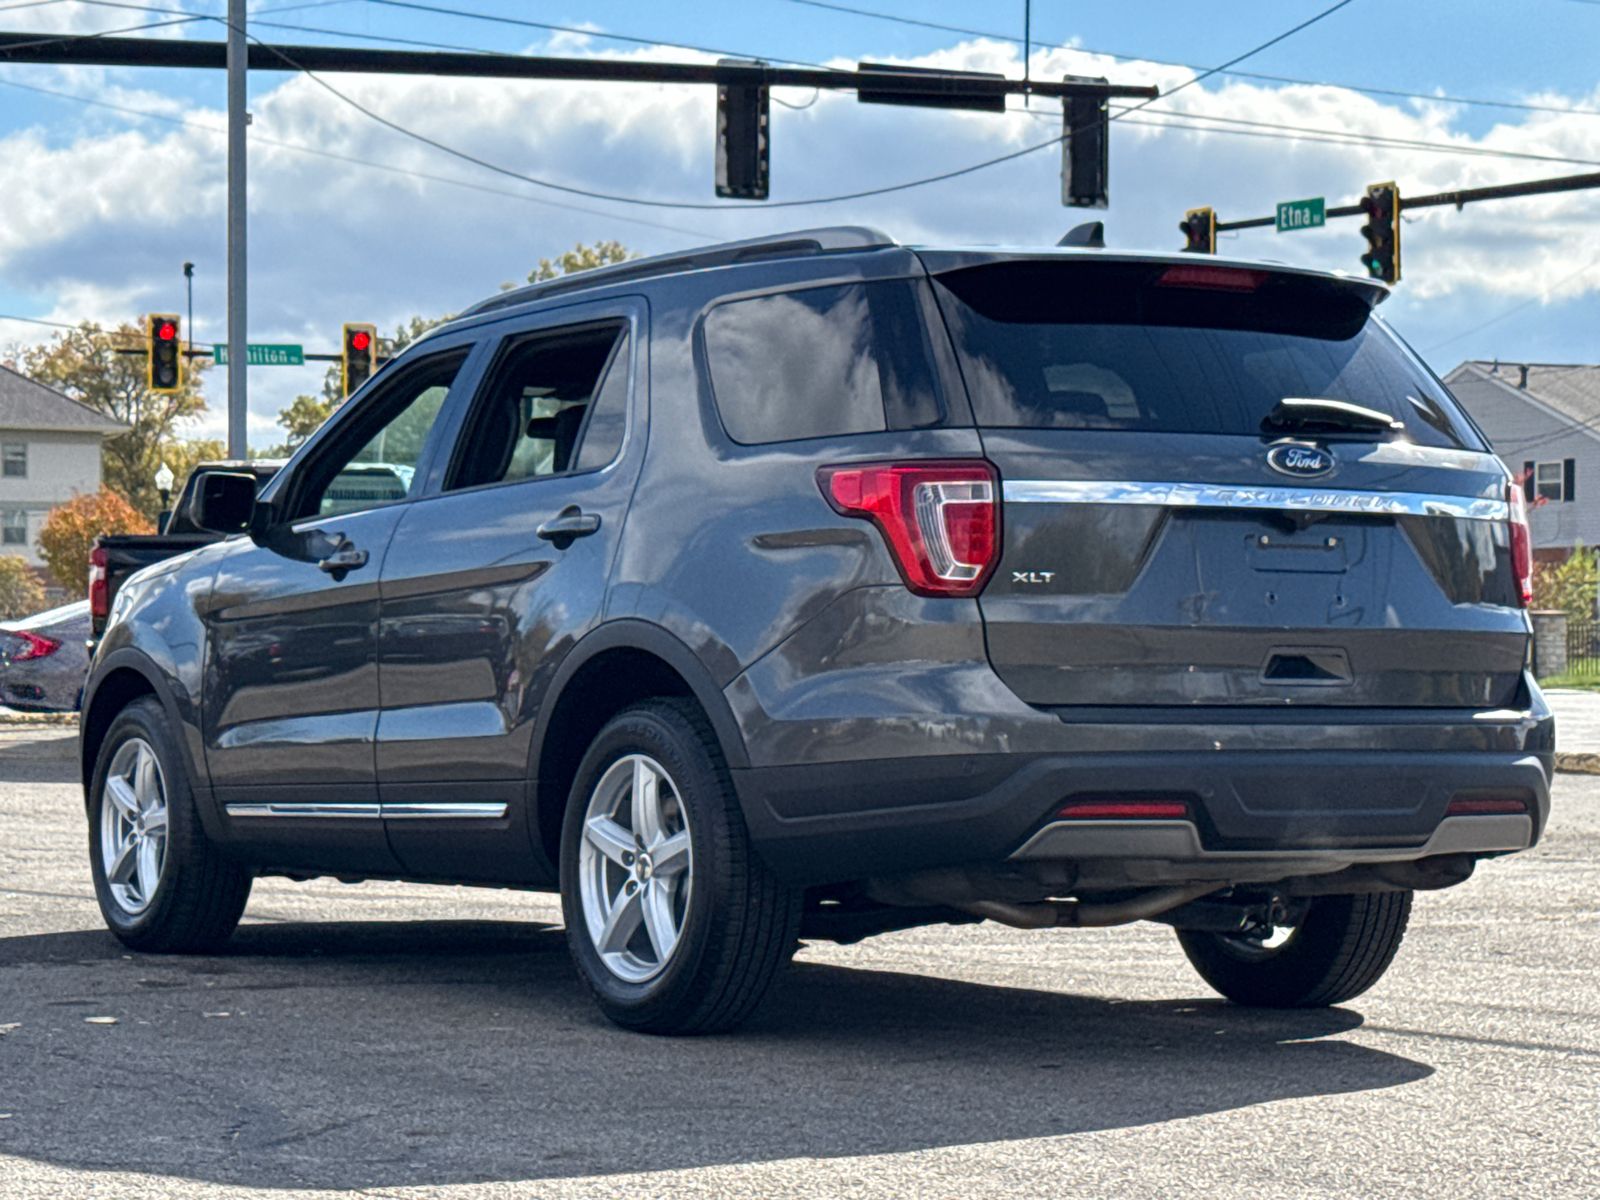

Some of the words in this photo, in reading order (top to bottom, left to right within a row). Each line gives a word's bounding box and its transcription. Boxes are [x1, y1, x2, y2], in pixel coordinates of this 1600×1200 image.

[1280, 206, 1311, 228] Etna
[220, 346, 288, 363] Hilton
[1285, 448, 1322, 469] Ford
[1012, 571, 1056, 583] XLT
